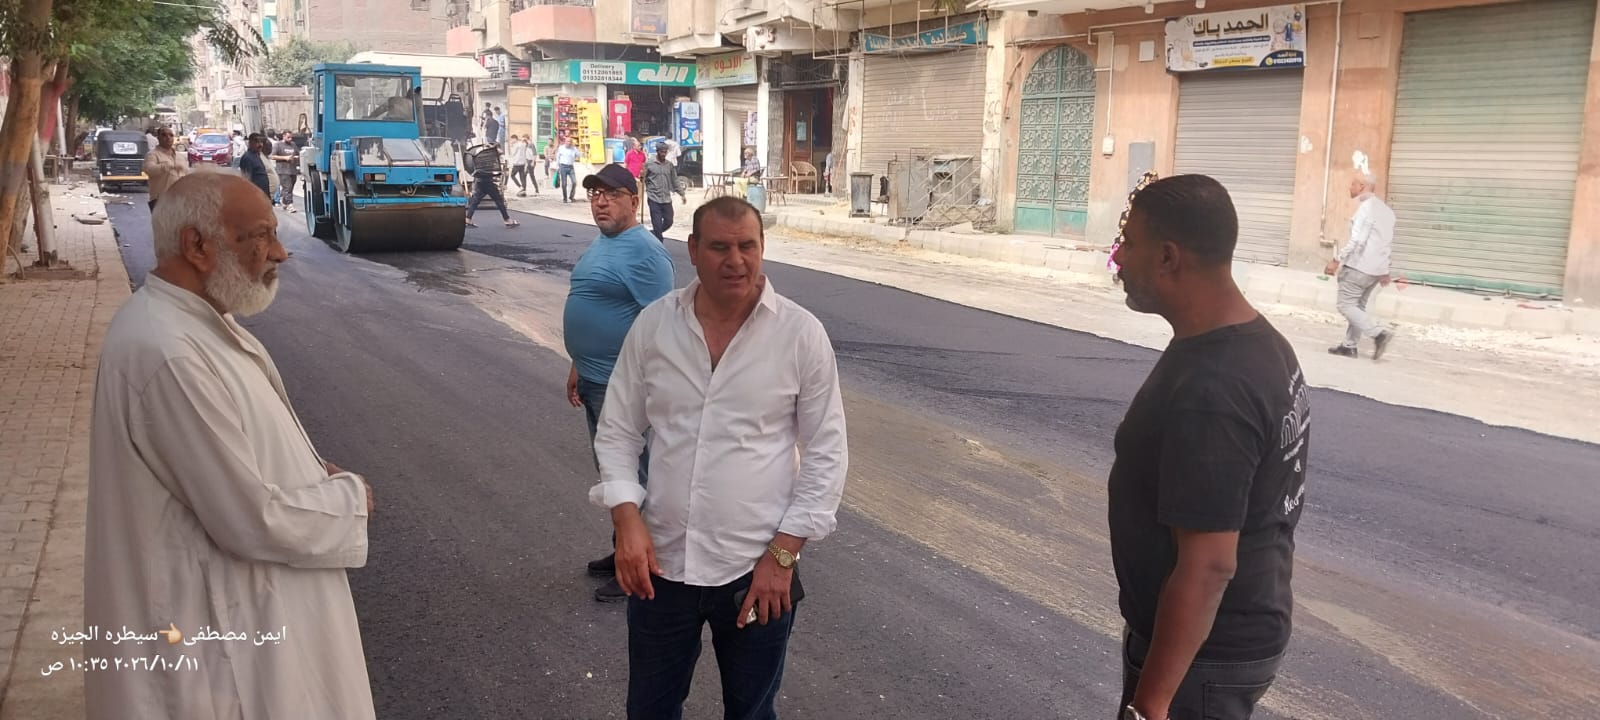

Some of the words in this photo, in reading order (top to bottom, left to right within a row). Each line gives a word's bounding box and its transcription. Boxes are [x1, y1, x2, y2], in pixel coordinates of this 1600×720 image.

[1193, 18, 1220, 39] باك
[1223, 13, 1269, 34] الحمد
[637, 63, 689, 83] الله
